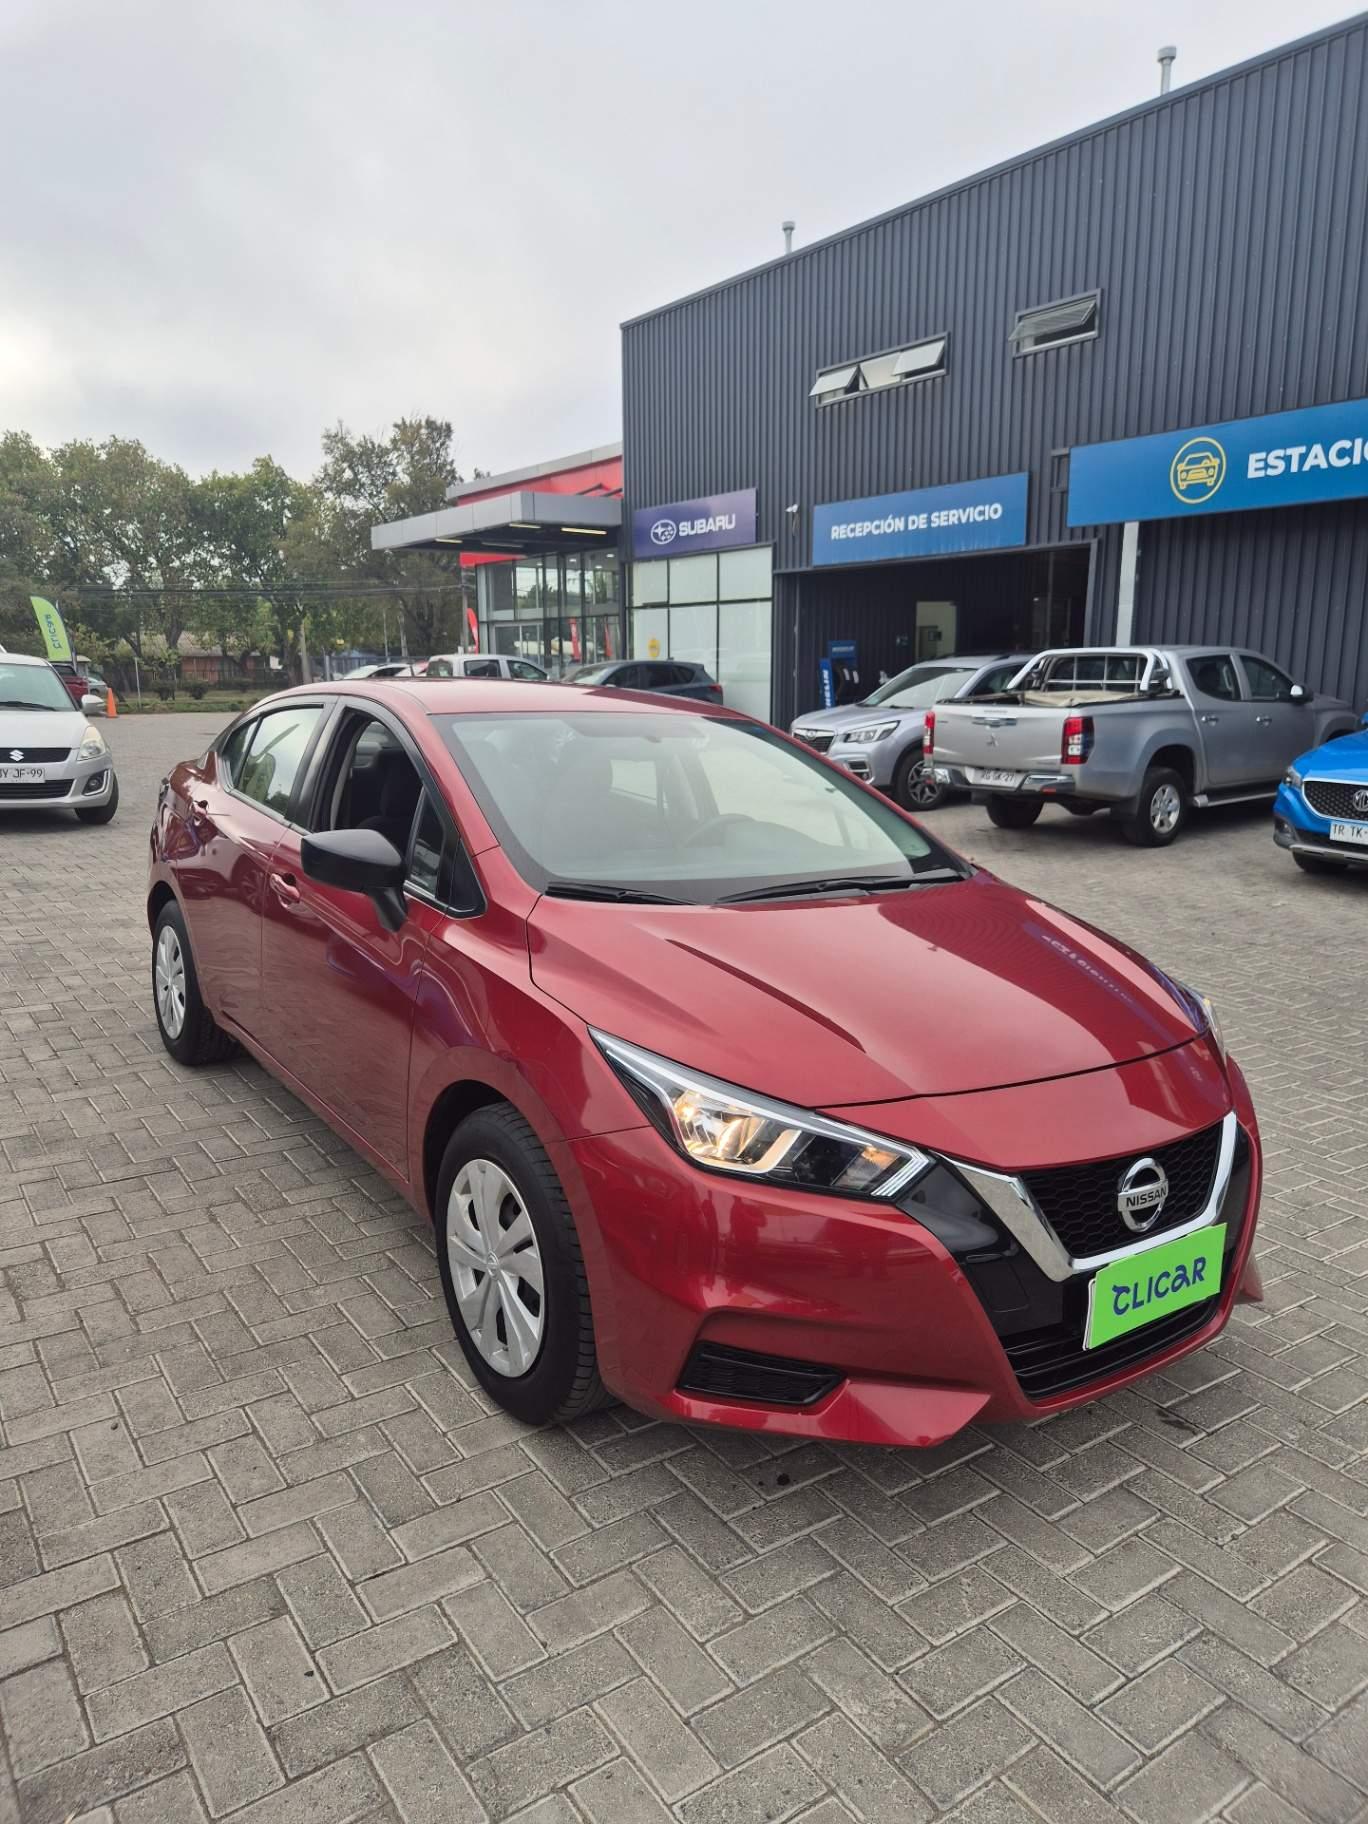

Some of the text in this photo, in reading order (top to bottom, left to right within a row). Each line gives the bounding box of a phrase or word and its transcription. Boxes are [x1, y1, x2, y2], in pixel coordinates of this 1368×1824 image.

[679, 513, 736, 537] SUBARU
[831, 502, 1003, 540] RECEPCIÓN DE SERVICIO
[1126, 1185, 1167, 1208] NISSAN
